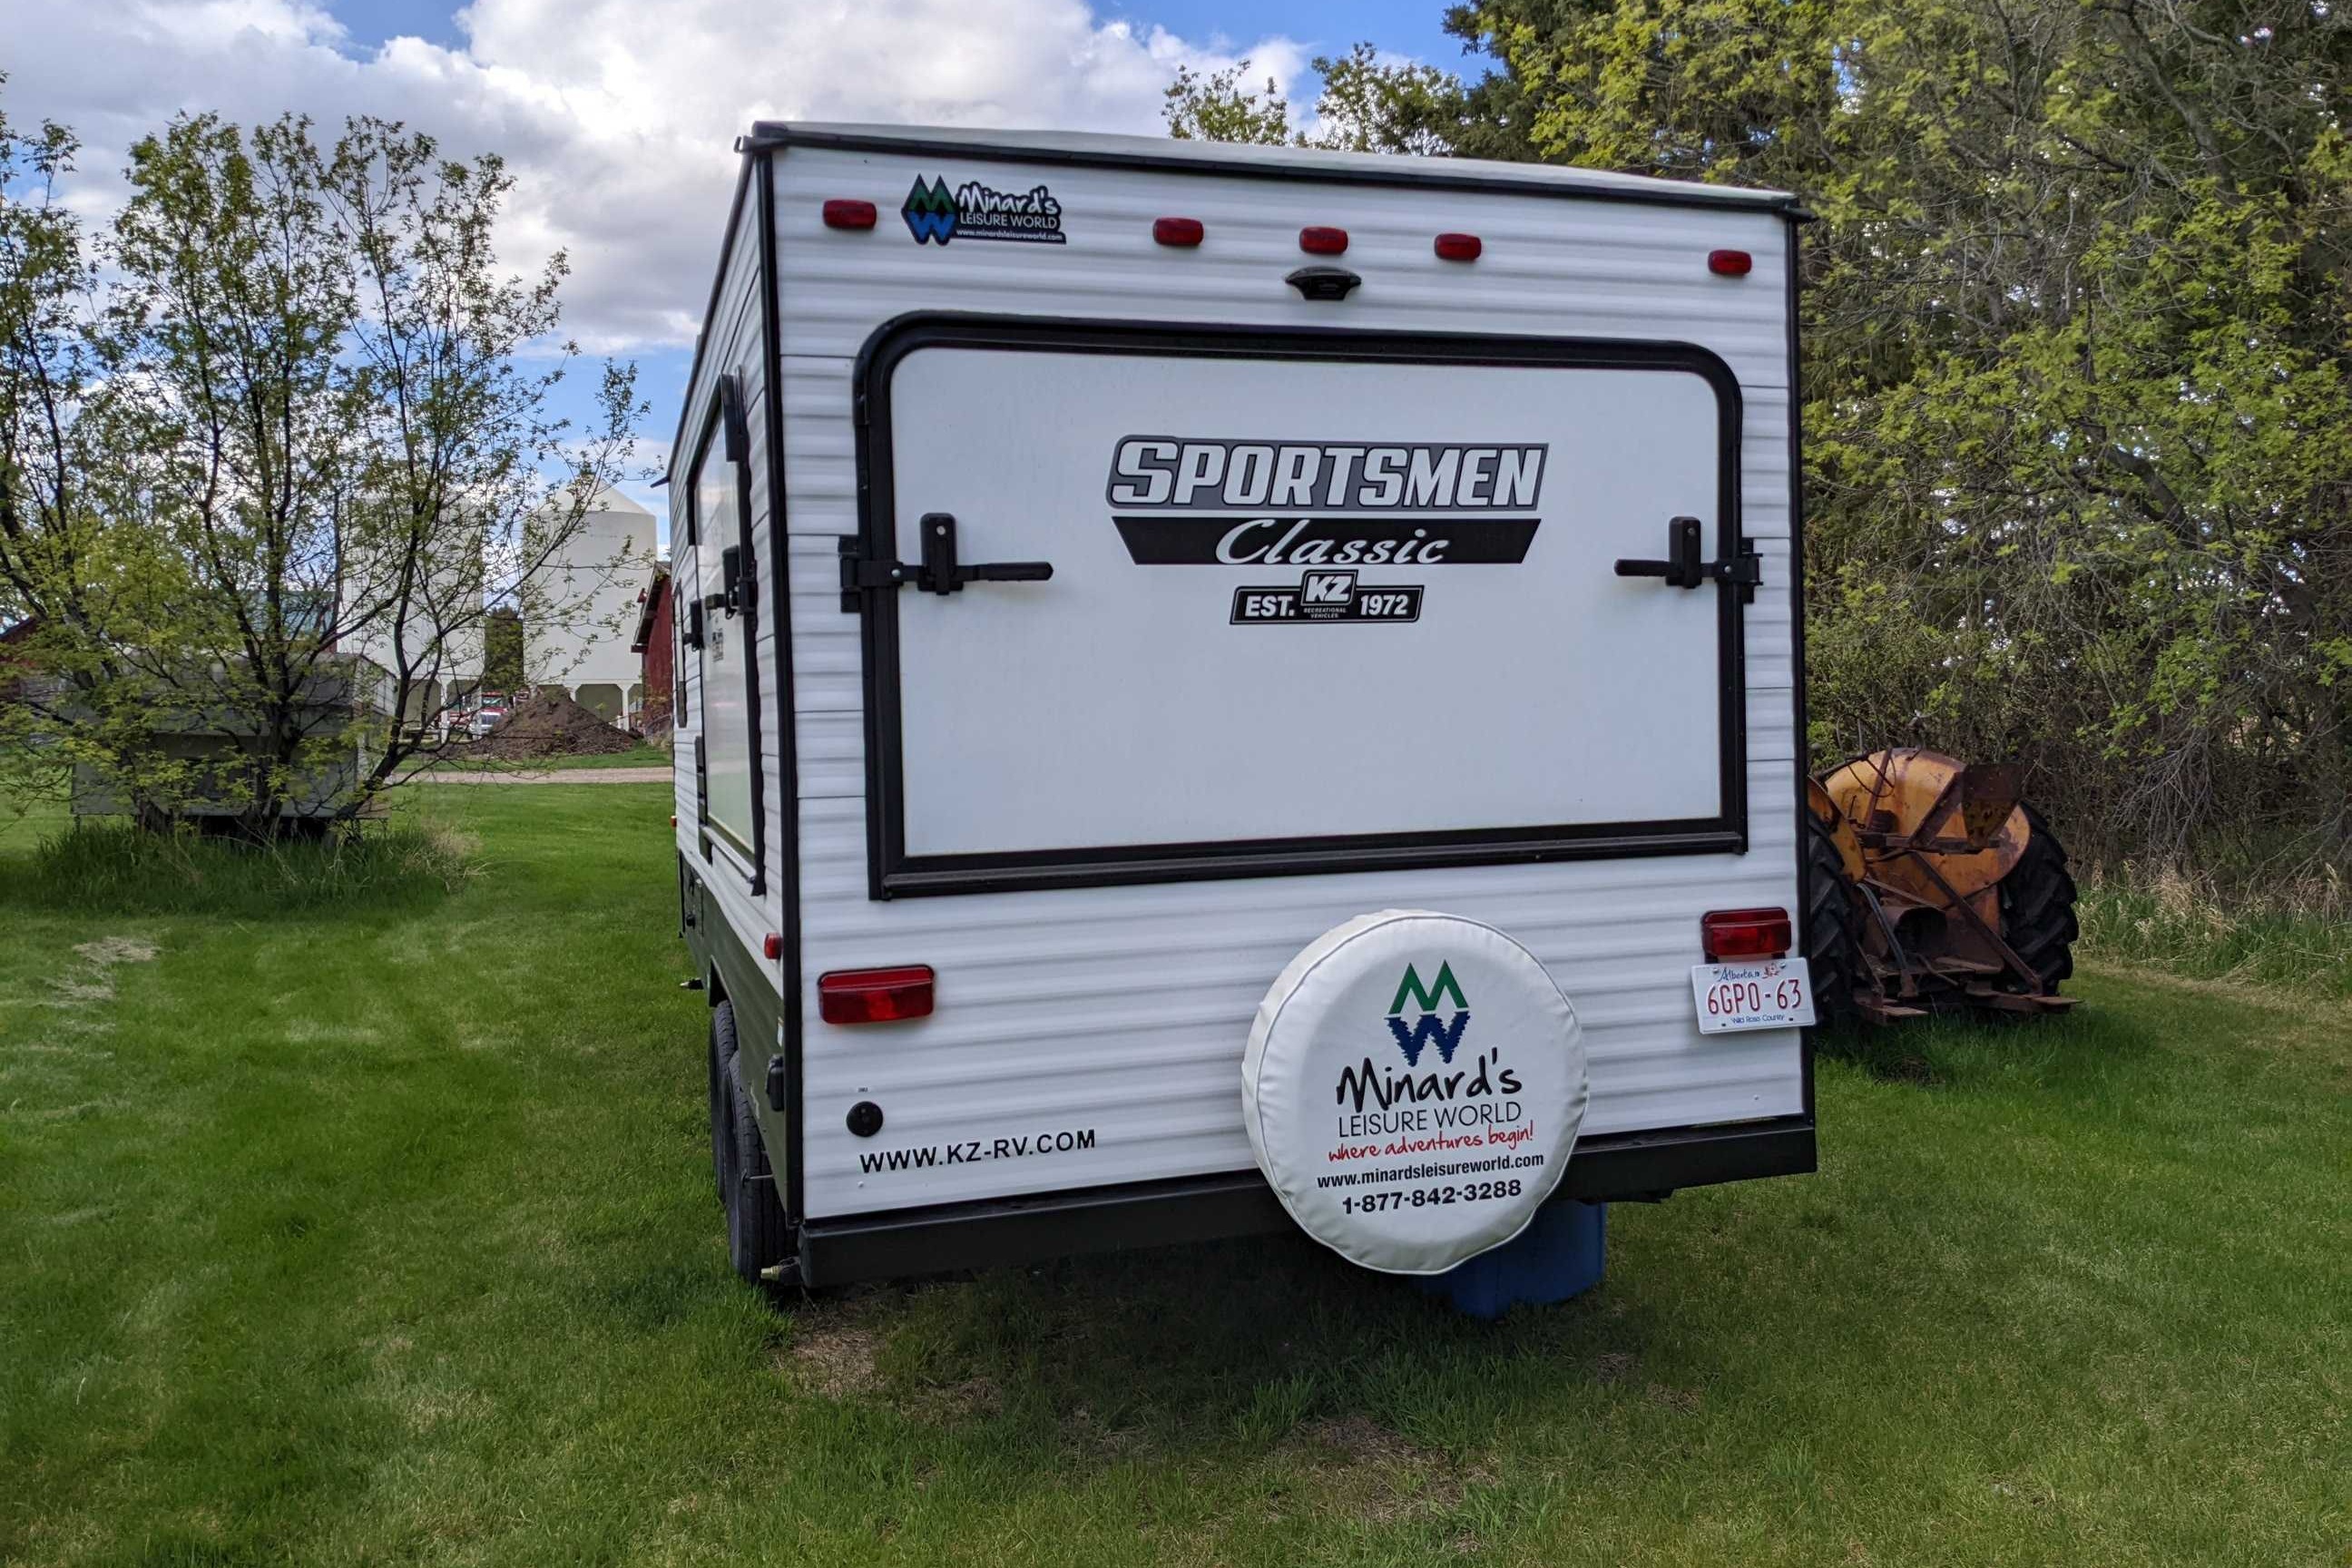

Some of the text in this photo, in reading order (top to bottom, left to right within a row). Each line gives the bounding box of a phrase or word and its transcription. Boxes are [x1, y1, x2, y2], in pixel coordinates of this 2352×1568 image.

[959, 185, 1058, 215] Minard's
[956, 229, 1063, 240] www.minardsleisureworld.com
[960, 212, 1057, 229] LEISURE WORLD
[1111, 440, 1543, 507] SPORTSMEN
[1215, 519, 1450, 564] Classic
[1245, 594, 1408, 617] EST. 1972
[1306, 575, 1352, 603] KZ
[1718, 966, 1758, 982] Alberta
[1336, 1047, 1523, 1113] Minard's
[1338, 1102, 1522, 1138] LEISURE WORLD
[859, 1129, 1095, 1173] WWW.KZ-RV.COM
[1328, 1120, 1534, 1163] where adventures begin!
[1318, 1153, 1544, 1189] www.minardsleisureworld.com
[1342, 1180, 1522, 1214] 1-877-842-3288
